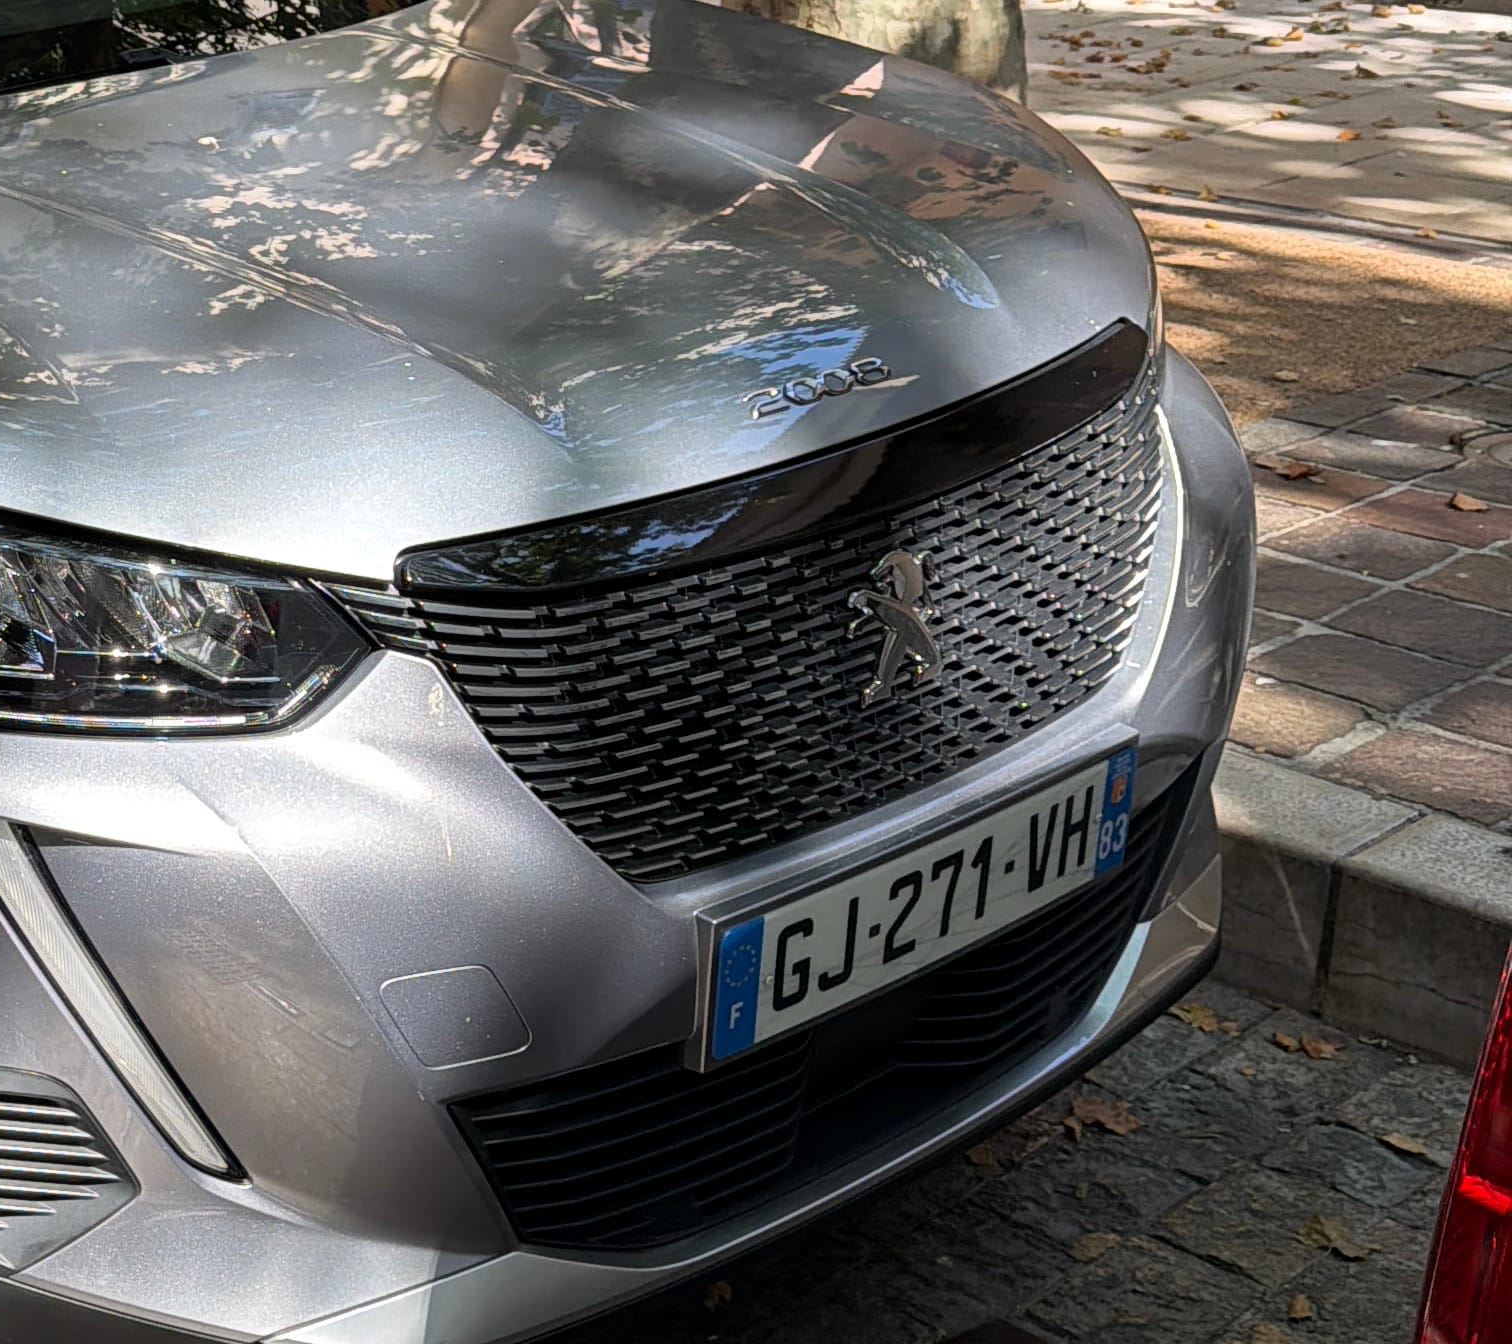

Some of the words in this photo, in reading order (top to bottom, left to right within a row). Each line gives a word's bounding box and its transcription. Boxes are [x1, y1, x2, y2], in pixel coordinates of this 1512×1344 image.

[741, 357, 891, 420] 2008
[1098, 812, 1128, 860] 83
[772, 785, 1095, 1011] GJ-271-VH
[728, 1001, 741, 1030] F
